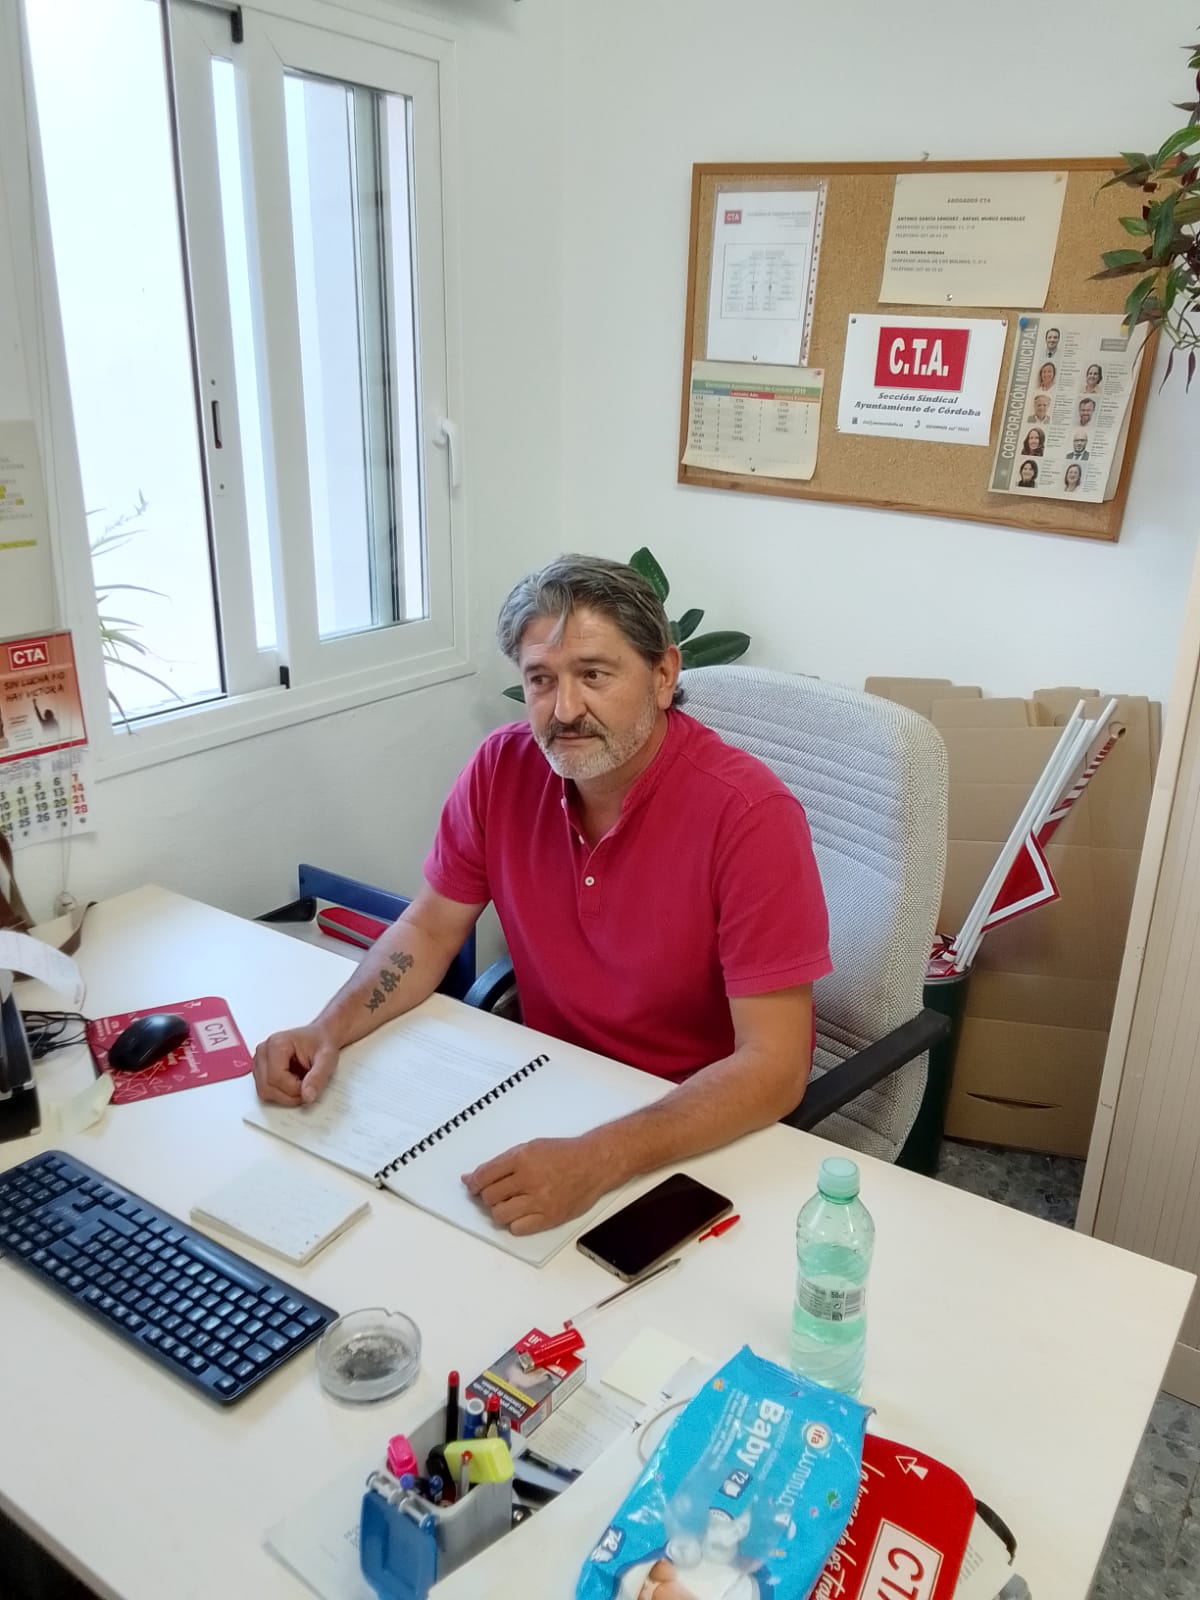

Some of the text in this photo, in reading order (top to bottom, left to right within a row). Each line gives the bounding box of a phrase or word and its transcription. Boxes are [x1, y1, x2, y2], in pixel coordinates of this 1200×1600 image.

[889, 336, 949, 377] C.T.A.
[878, 392, 959, 404] Sección Sindical
[1001, 323, 1038, 459] CORPORACIÓN MUNICIPAL
[854, 400, 981, 417] Ayuntamiento de Córdoba
[13, 647, 46, 665] CTA
[21, 673, 49, 687] LUCHA
[17, 786, 24, 795] 4
[35, 781, 42, 791] 5
[53, 776, 61, 787] 6
[71, 772, 79, 782] 7
[17, 796, 27, 806] 11
[34, 791, 47, 801] 12
[53, 786, 66, 797] 13
[71, 783, 85, 793] 14
[0, 794, 86, 822] 17 18 19 20 21
[18, 816, 31, 828] 25
[35, 812, 50, 823] 26
[55, 808, 68, 819] 27
[73, 804, 89, 815] 28
[204, 1022, 229, 1047] CTA
[735, 1397, 786, 1469] Baby
[810, 1427, 826, 1446] ifa
[730, 1470, 750, 1485] 72
[601, 1528, 623, 1553] 72
[878, 1546, 926, 1600] CT
